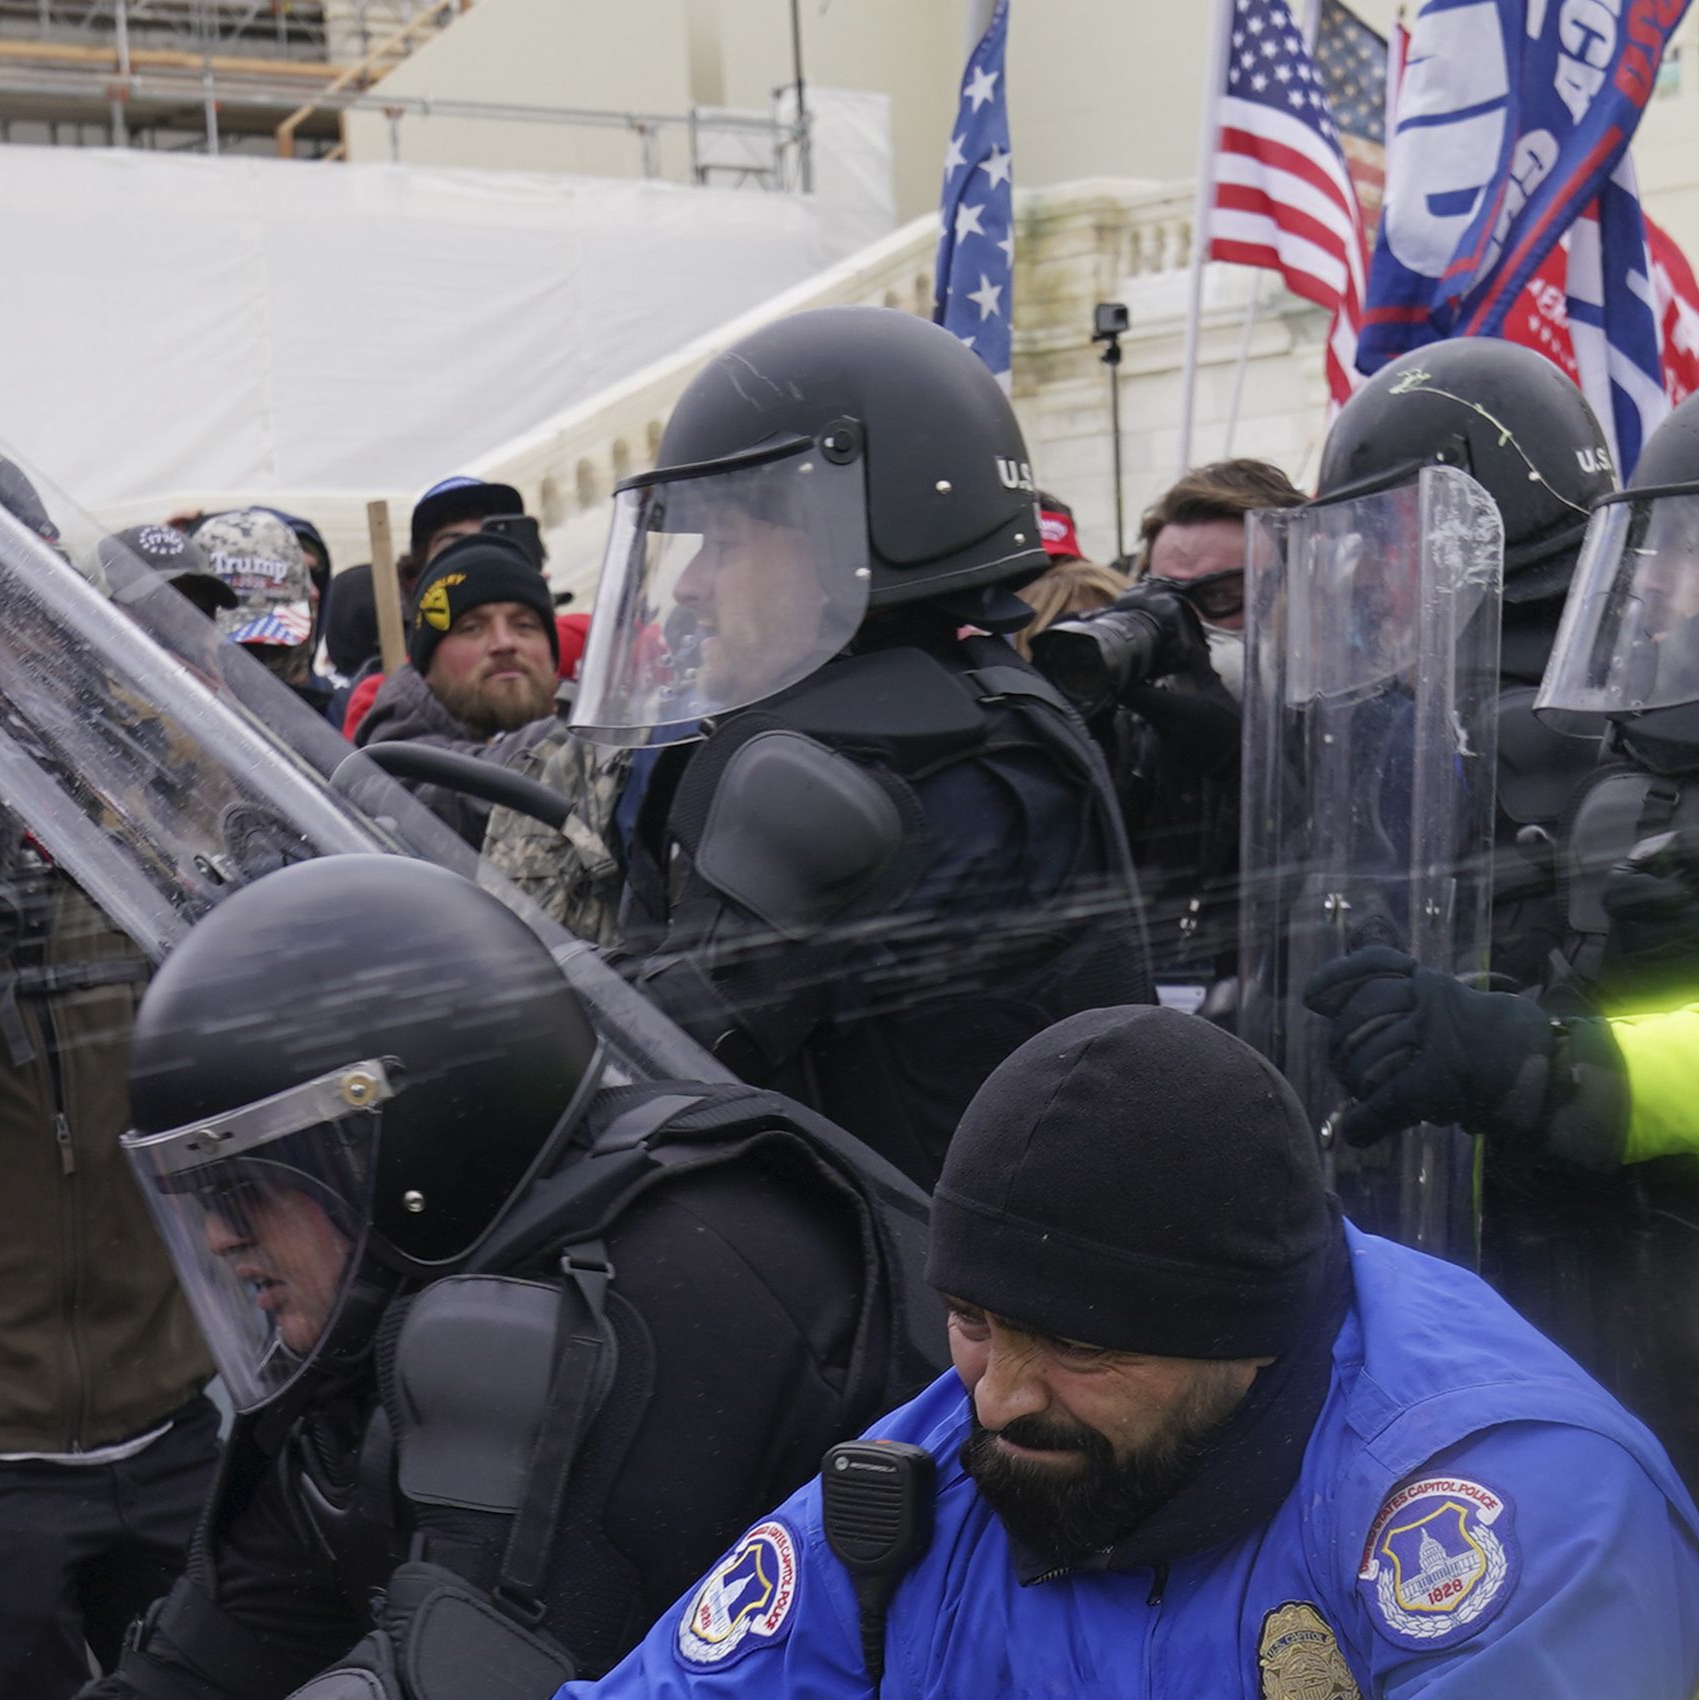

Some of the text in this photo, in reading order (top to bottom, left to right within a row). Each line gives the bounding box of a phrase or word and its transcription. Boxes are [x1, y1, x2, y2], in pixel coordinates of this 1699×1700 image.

[210, 550, 288, 584] Trump
[1373, 1493, 1408, 1532] STATES
[1407, 1481, 1457, 1499] CAPITOL
[1458, 1484, 1499, 1511] POLICE
[780, 1546, 794, 1587] CAPITOL
[764, 1590, 791, 1631] POLICE
[1427, 1578, 1464, 1605] 1828
